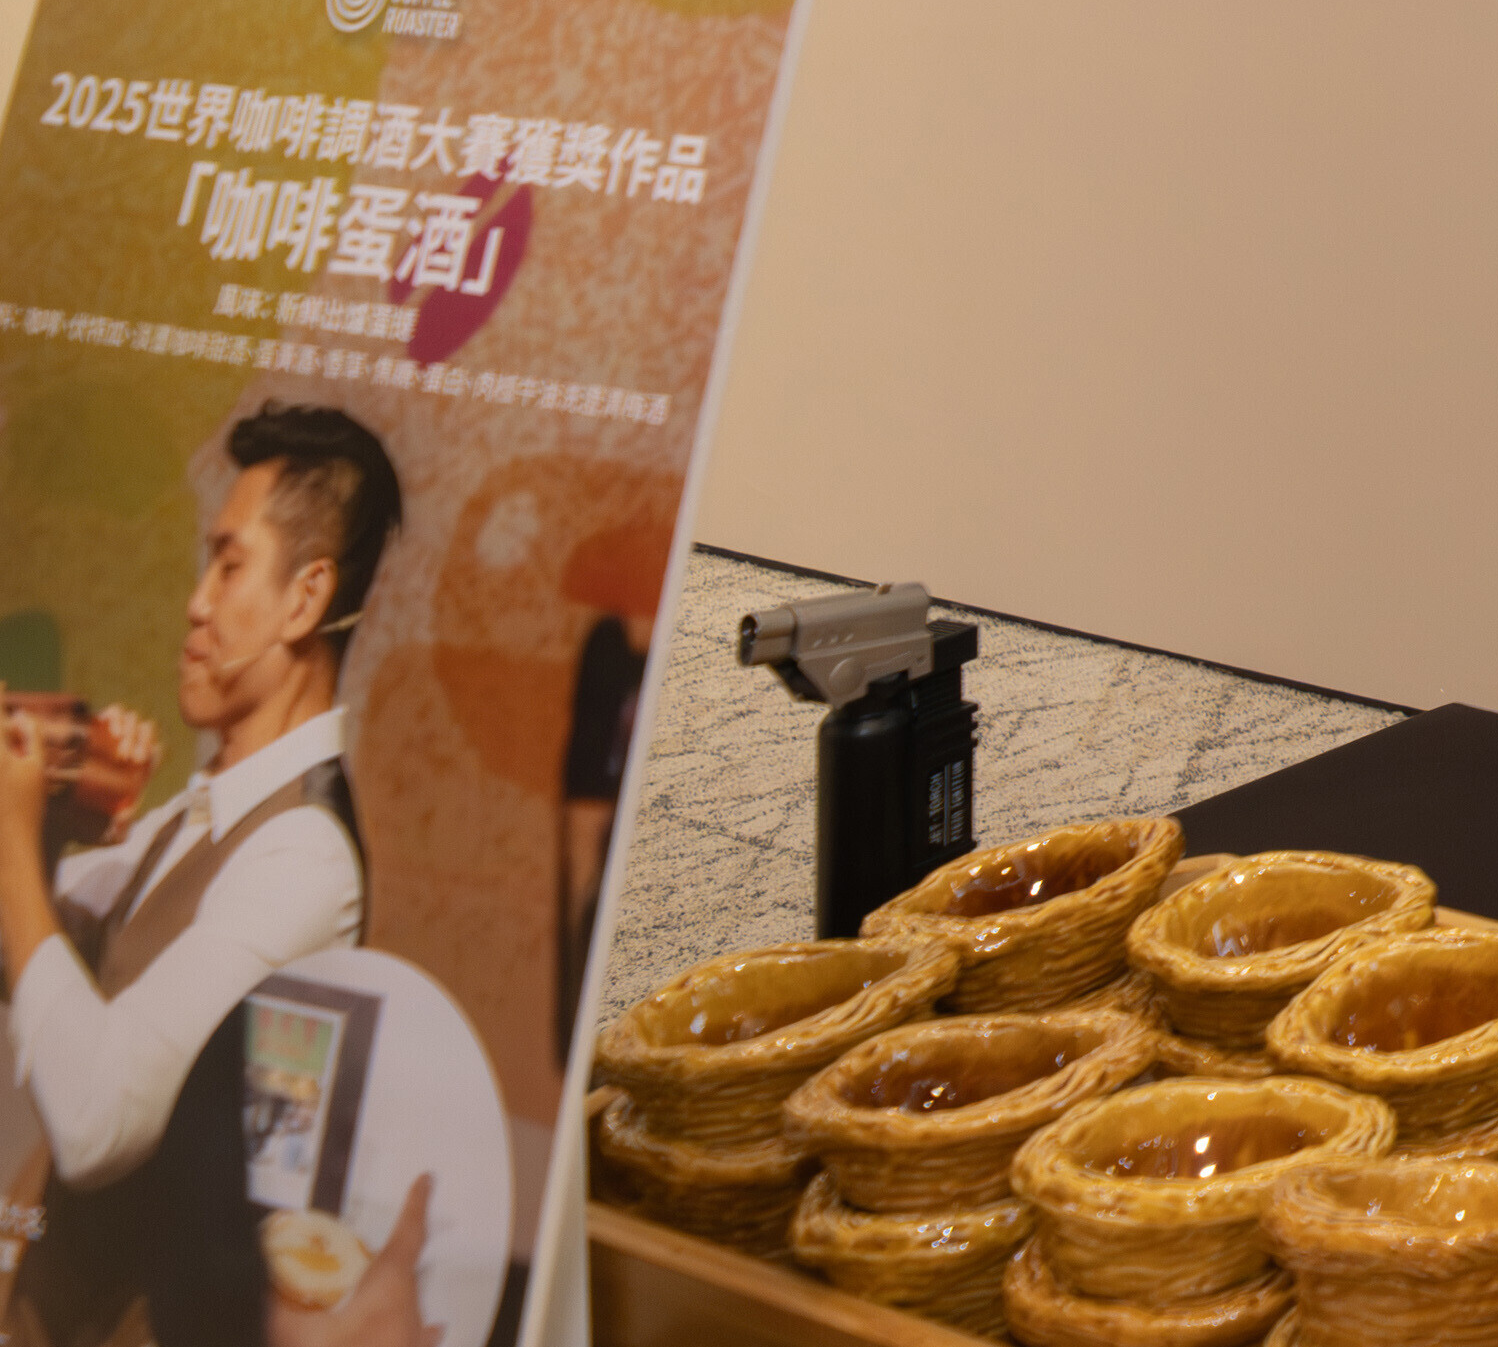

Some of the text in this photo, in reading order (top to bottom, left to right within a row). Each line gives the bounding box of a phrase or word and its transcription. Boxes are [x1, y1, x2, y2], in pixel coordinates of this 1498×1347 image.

[381, 7, 462, 41] ROASTER
[176, 159, 506, 297] 「咖啡蛋酒」
